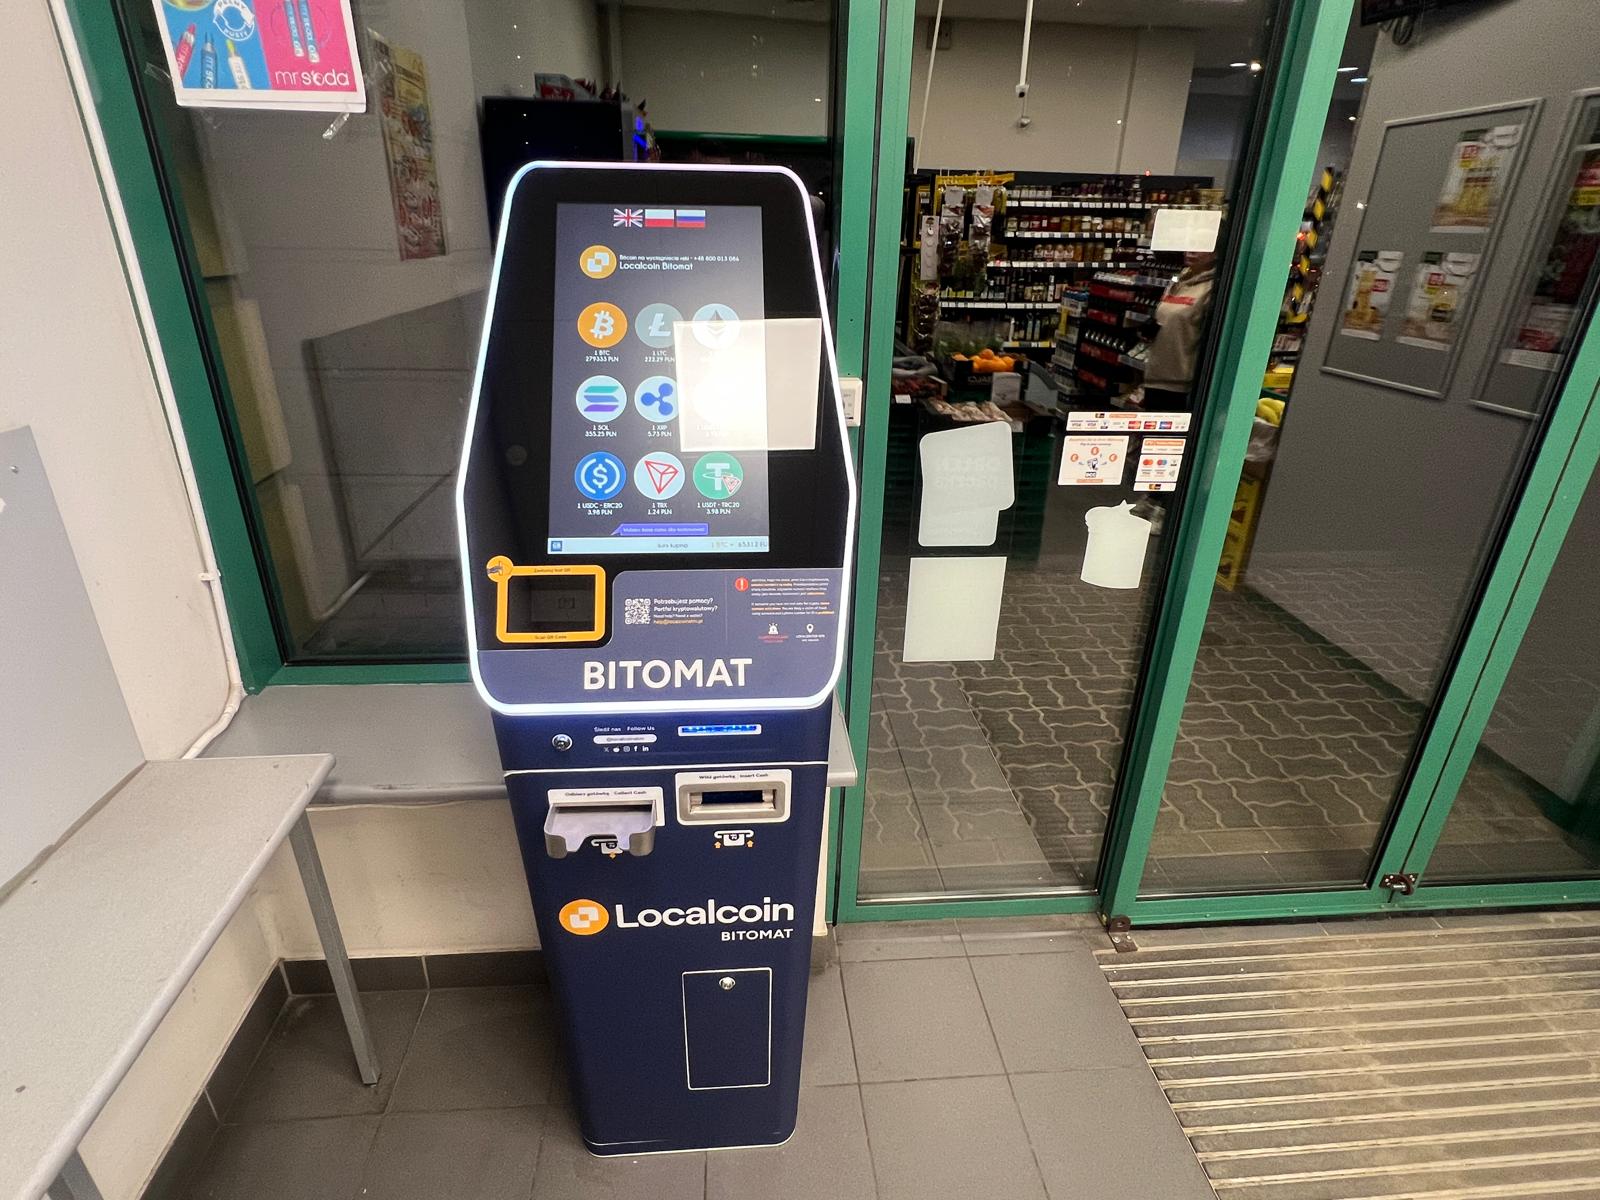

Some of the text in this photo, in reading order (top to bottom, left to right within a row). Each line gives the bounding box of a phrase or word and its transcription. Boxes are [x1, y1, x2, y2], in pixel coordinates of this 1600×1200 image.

[619, 262, 693, 270] Localcoin Bitomat
[688, 597, 714, 605] pomocy?
[583, 657, 753, 690] BITOMAT
[615, 896, 794, 929] Localcoin
[721, 928, 794, 941] BITOMAT
